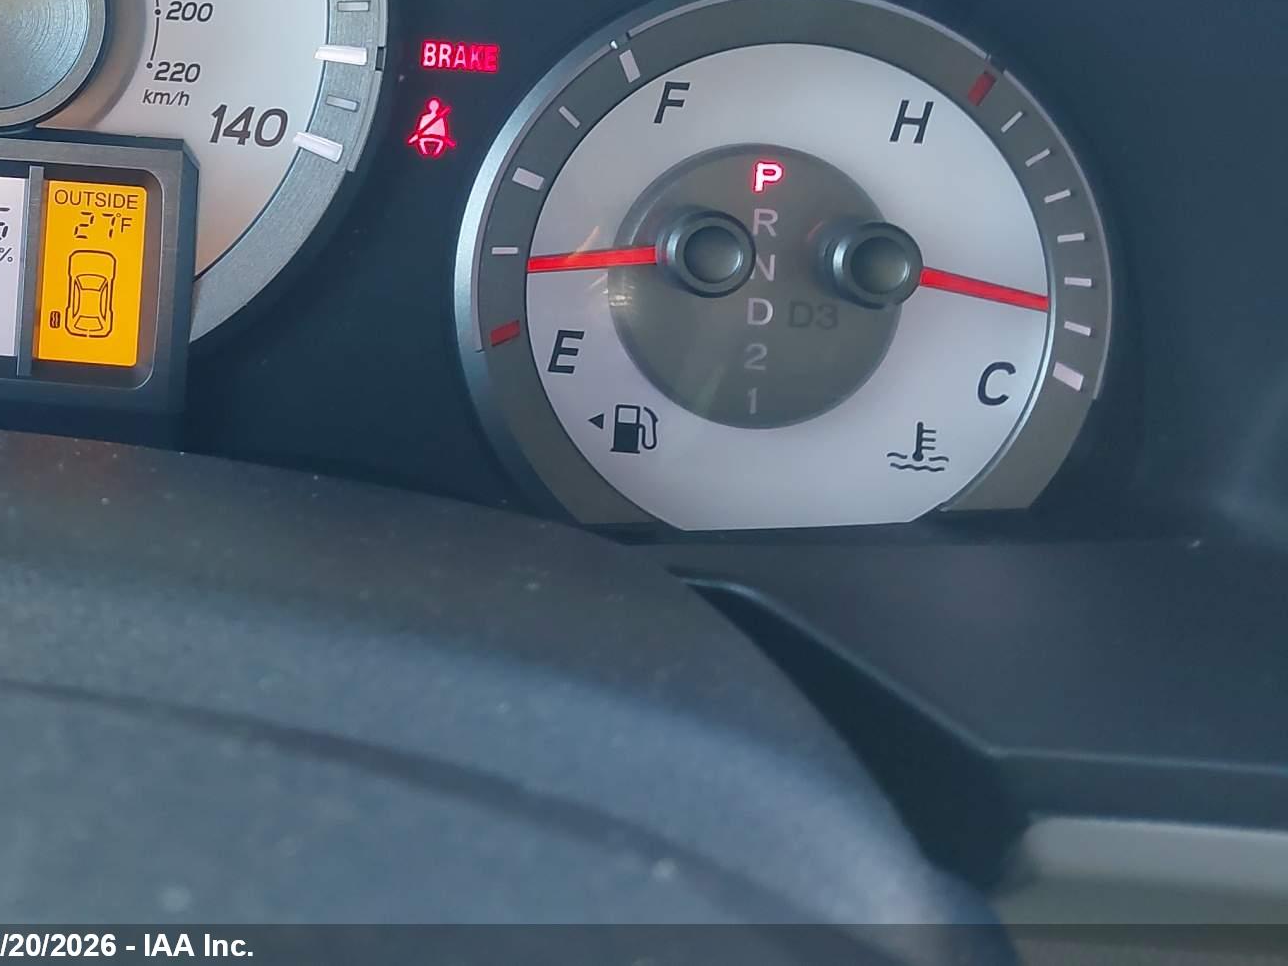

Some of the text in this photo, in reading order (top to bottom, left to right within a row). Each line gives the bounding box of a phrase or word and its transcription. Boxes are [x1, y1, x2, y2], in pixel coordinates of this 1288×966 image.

[167, 1, 213, 23] 200
[423, 42, 499, 73] BRAKE
[154, 62, 201, 84] 220
[143, 86, 190, 108] km/h
[654, 81, 690, 124] F
[210, 106, 288, 147] 140
[889, 100, 935, 144] H
[754, 162, 783, 192] P
[54, 188, 139, 210] OUTSIDE
[753, 208, 778, 237] R
[750, 254, 776, 281] N
[747, 298, 773, 325] D
[788, 301, 838, 329] D3
[548, 330, 584, 374] E
[744, 343, 768, 370] 2
[977, 361, 1017, 407] C
[748, 388, 758, 415] 1
